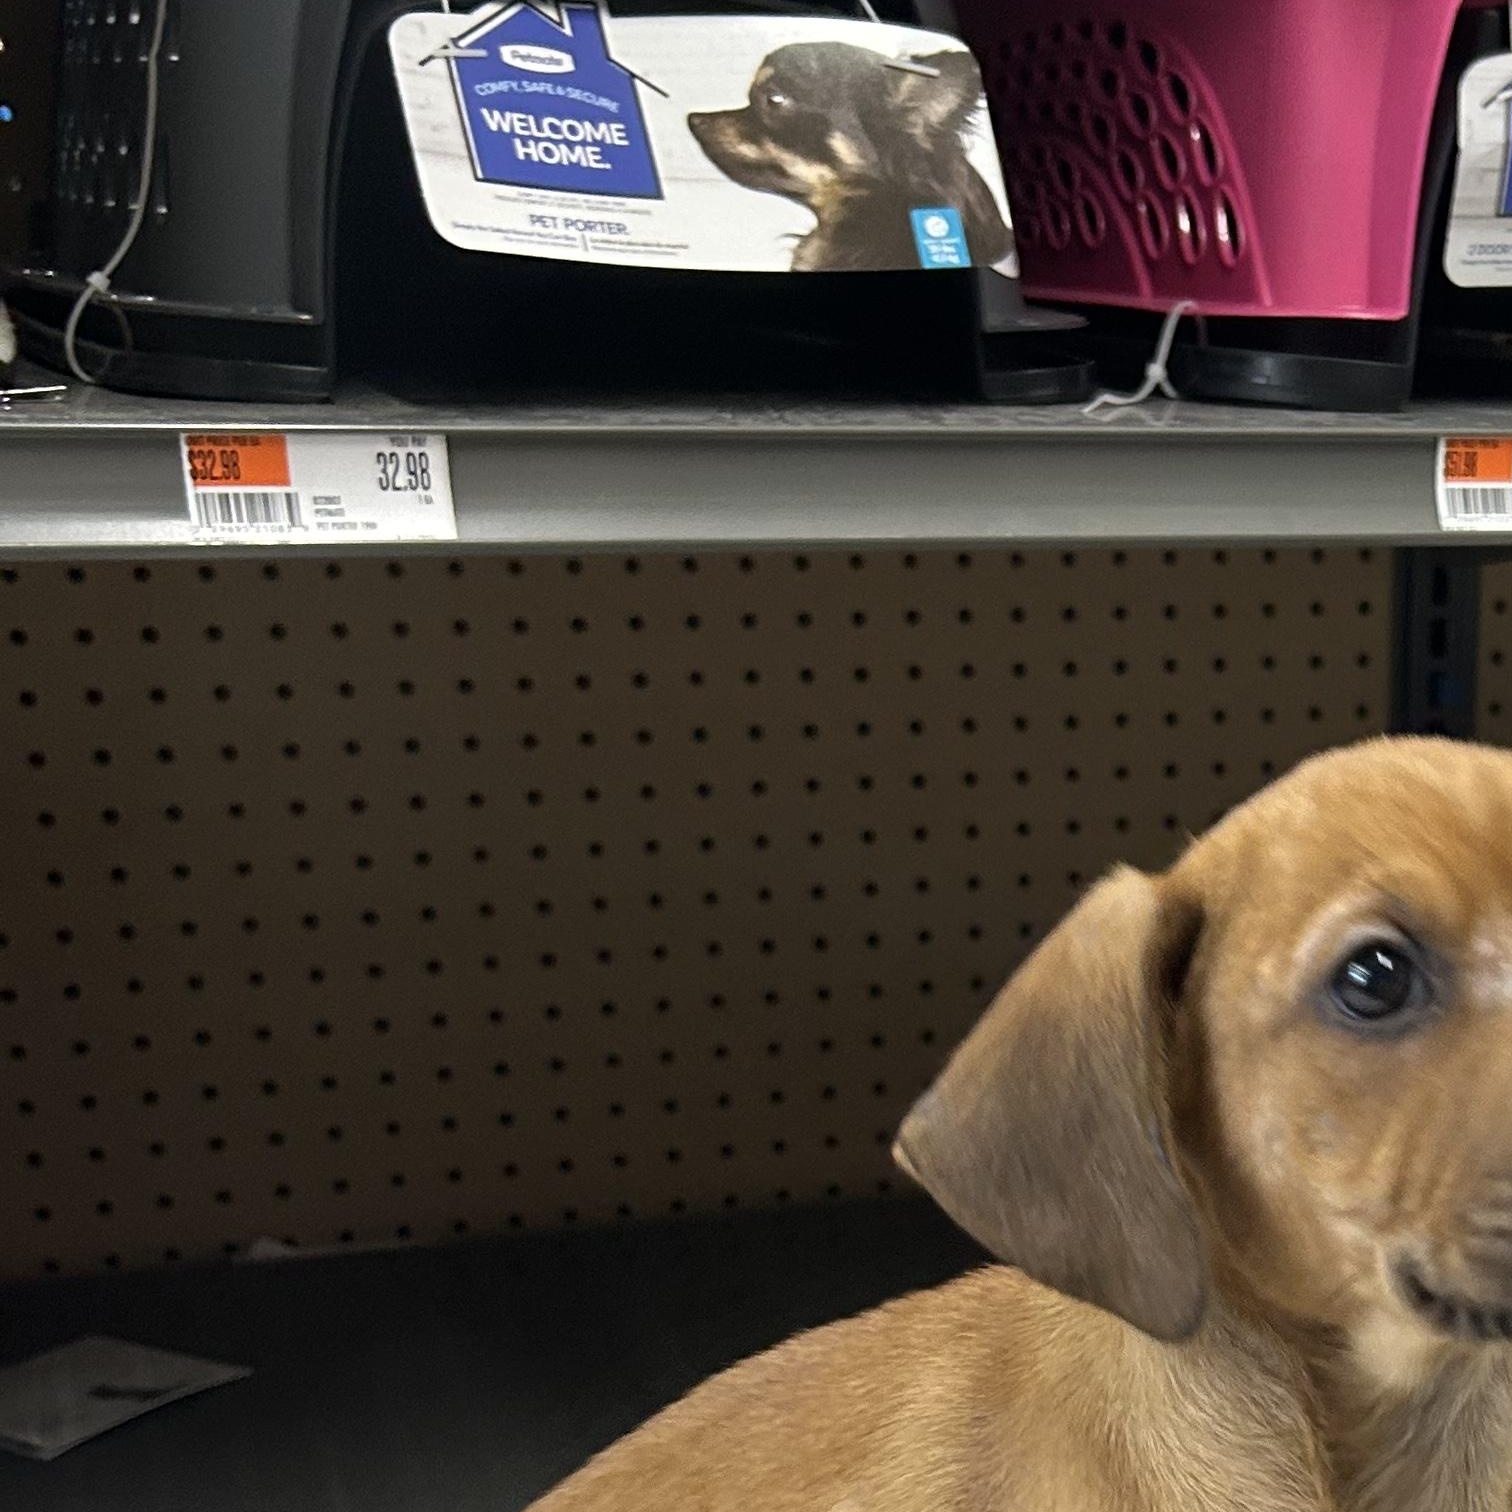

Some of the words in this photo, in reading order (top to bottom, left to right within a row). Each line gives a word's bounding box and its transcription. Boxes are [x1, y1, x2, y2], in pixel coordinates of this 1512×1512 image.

[480, 107, 630, 146] WELCOME
[529, 213, 558, 230] PET
[188, 449, 241, 480] $32.98
[377, 451, 431, 491] 32.98
